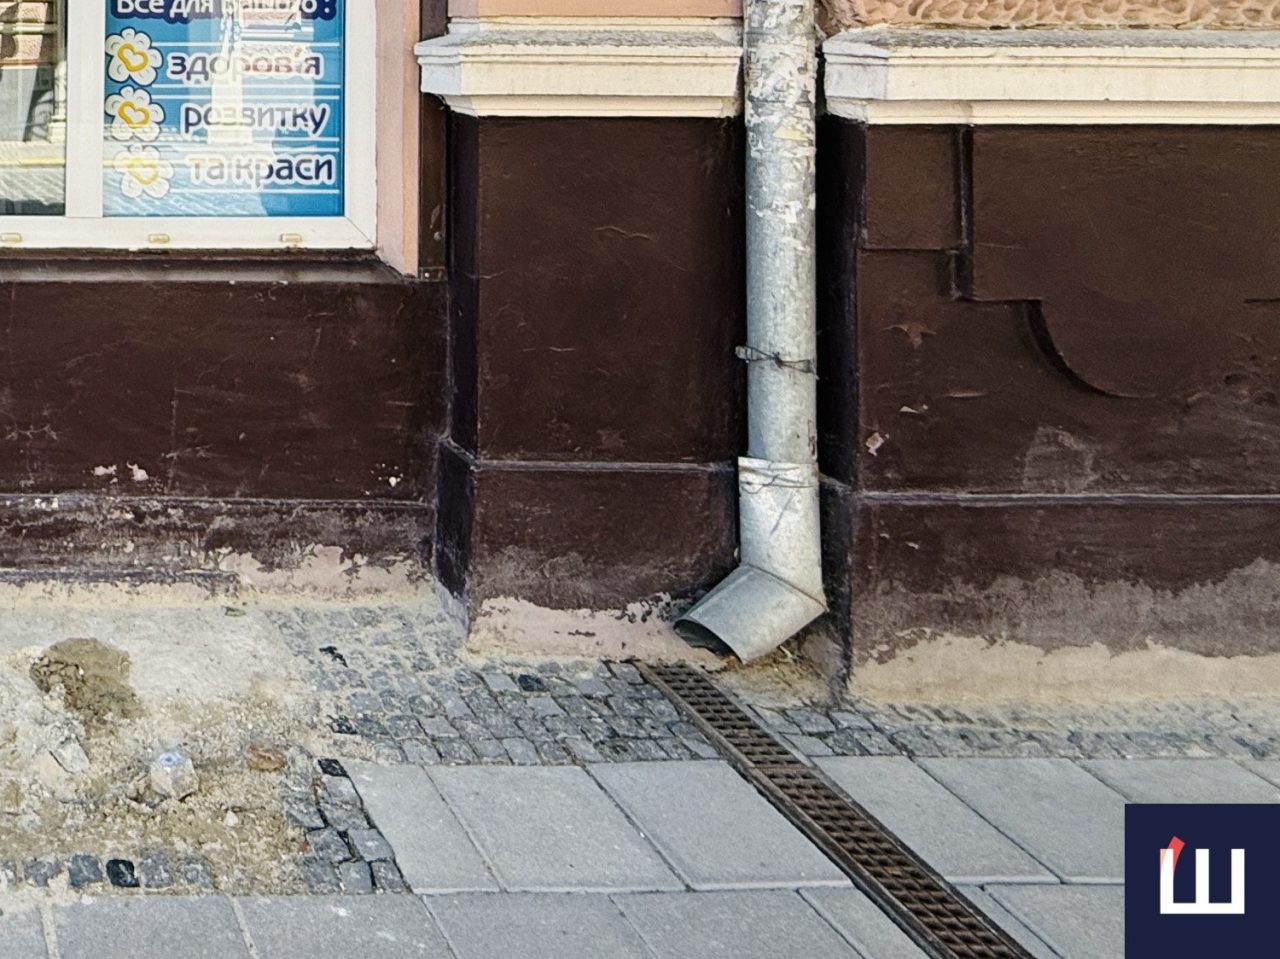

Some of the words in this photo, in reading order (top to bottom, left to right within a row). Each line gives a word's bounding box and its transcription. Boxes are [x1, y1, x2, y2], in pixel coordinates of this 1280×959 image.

[185, 106, 327, 134] розвитку
[189, 157, 224, 180] та
[235, 157, 332, 187] краси
